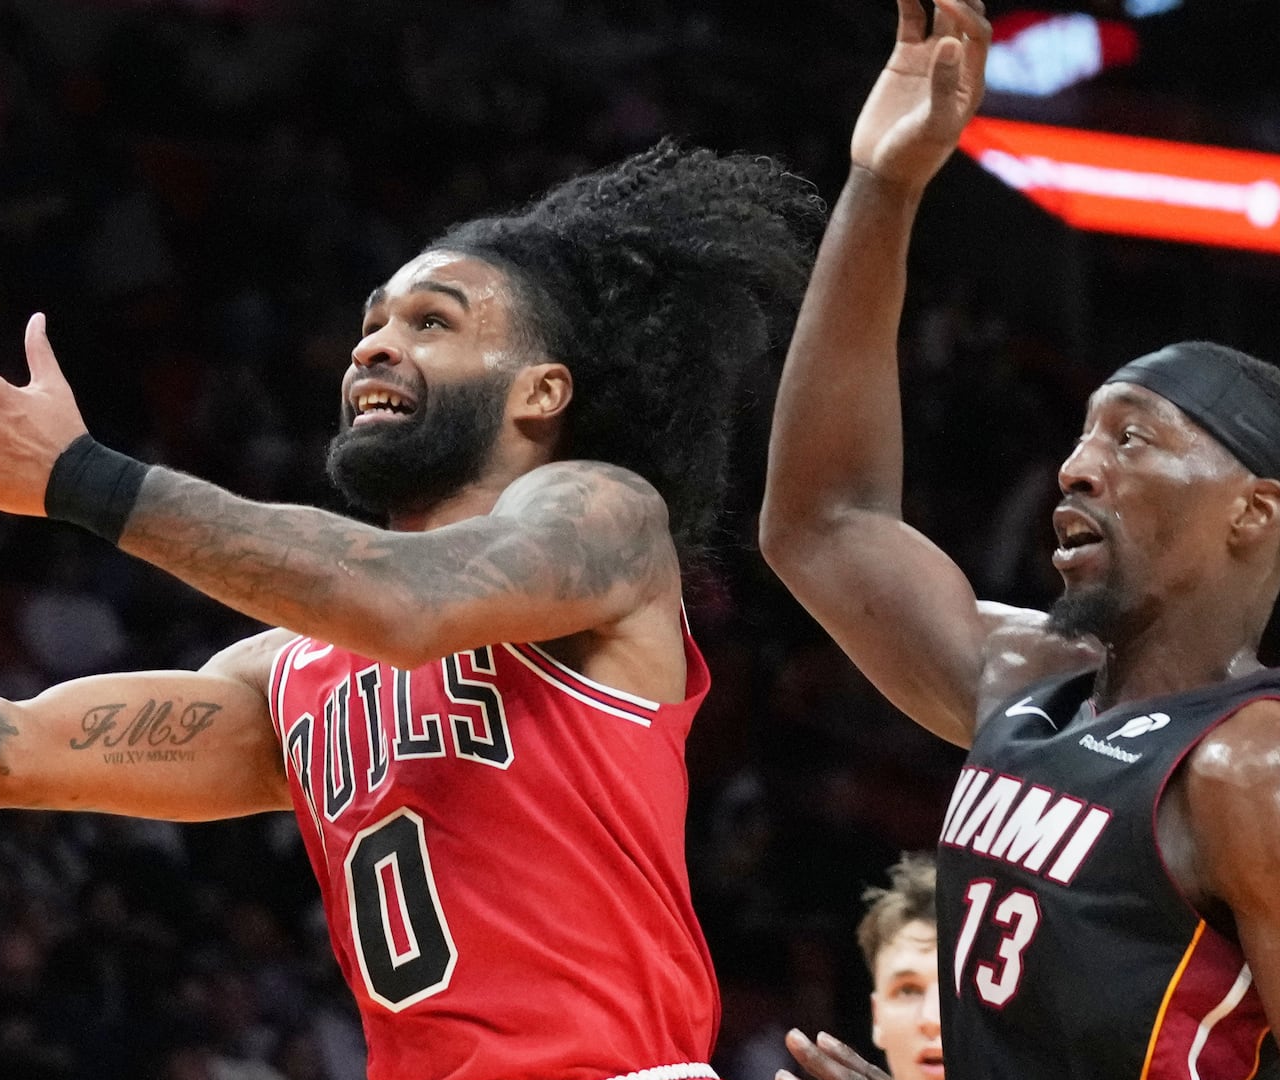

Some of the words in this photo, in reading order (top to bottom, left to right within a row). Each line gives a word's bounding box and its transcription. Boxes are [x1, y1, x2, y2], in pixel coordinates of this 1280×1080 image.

[70, 699, 222, 750] FMF
[1078, 733, 1143, 764] Robinhood
[344, 807, 458, 1013] 0
[953, 876, 1042, 1011] 13
